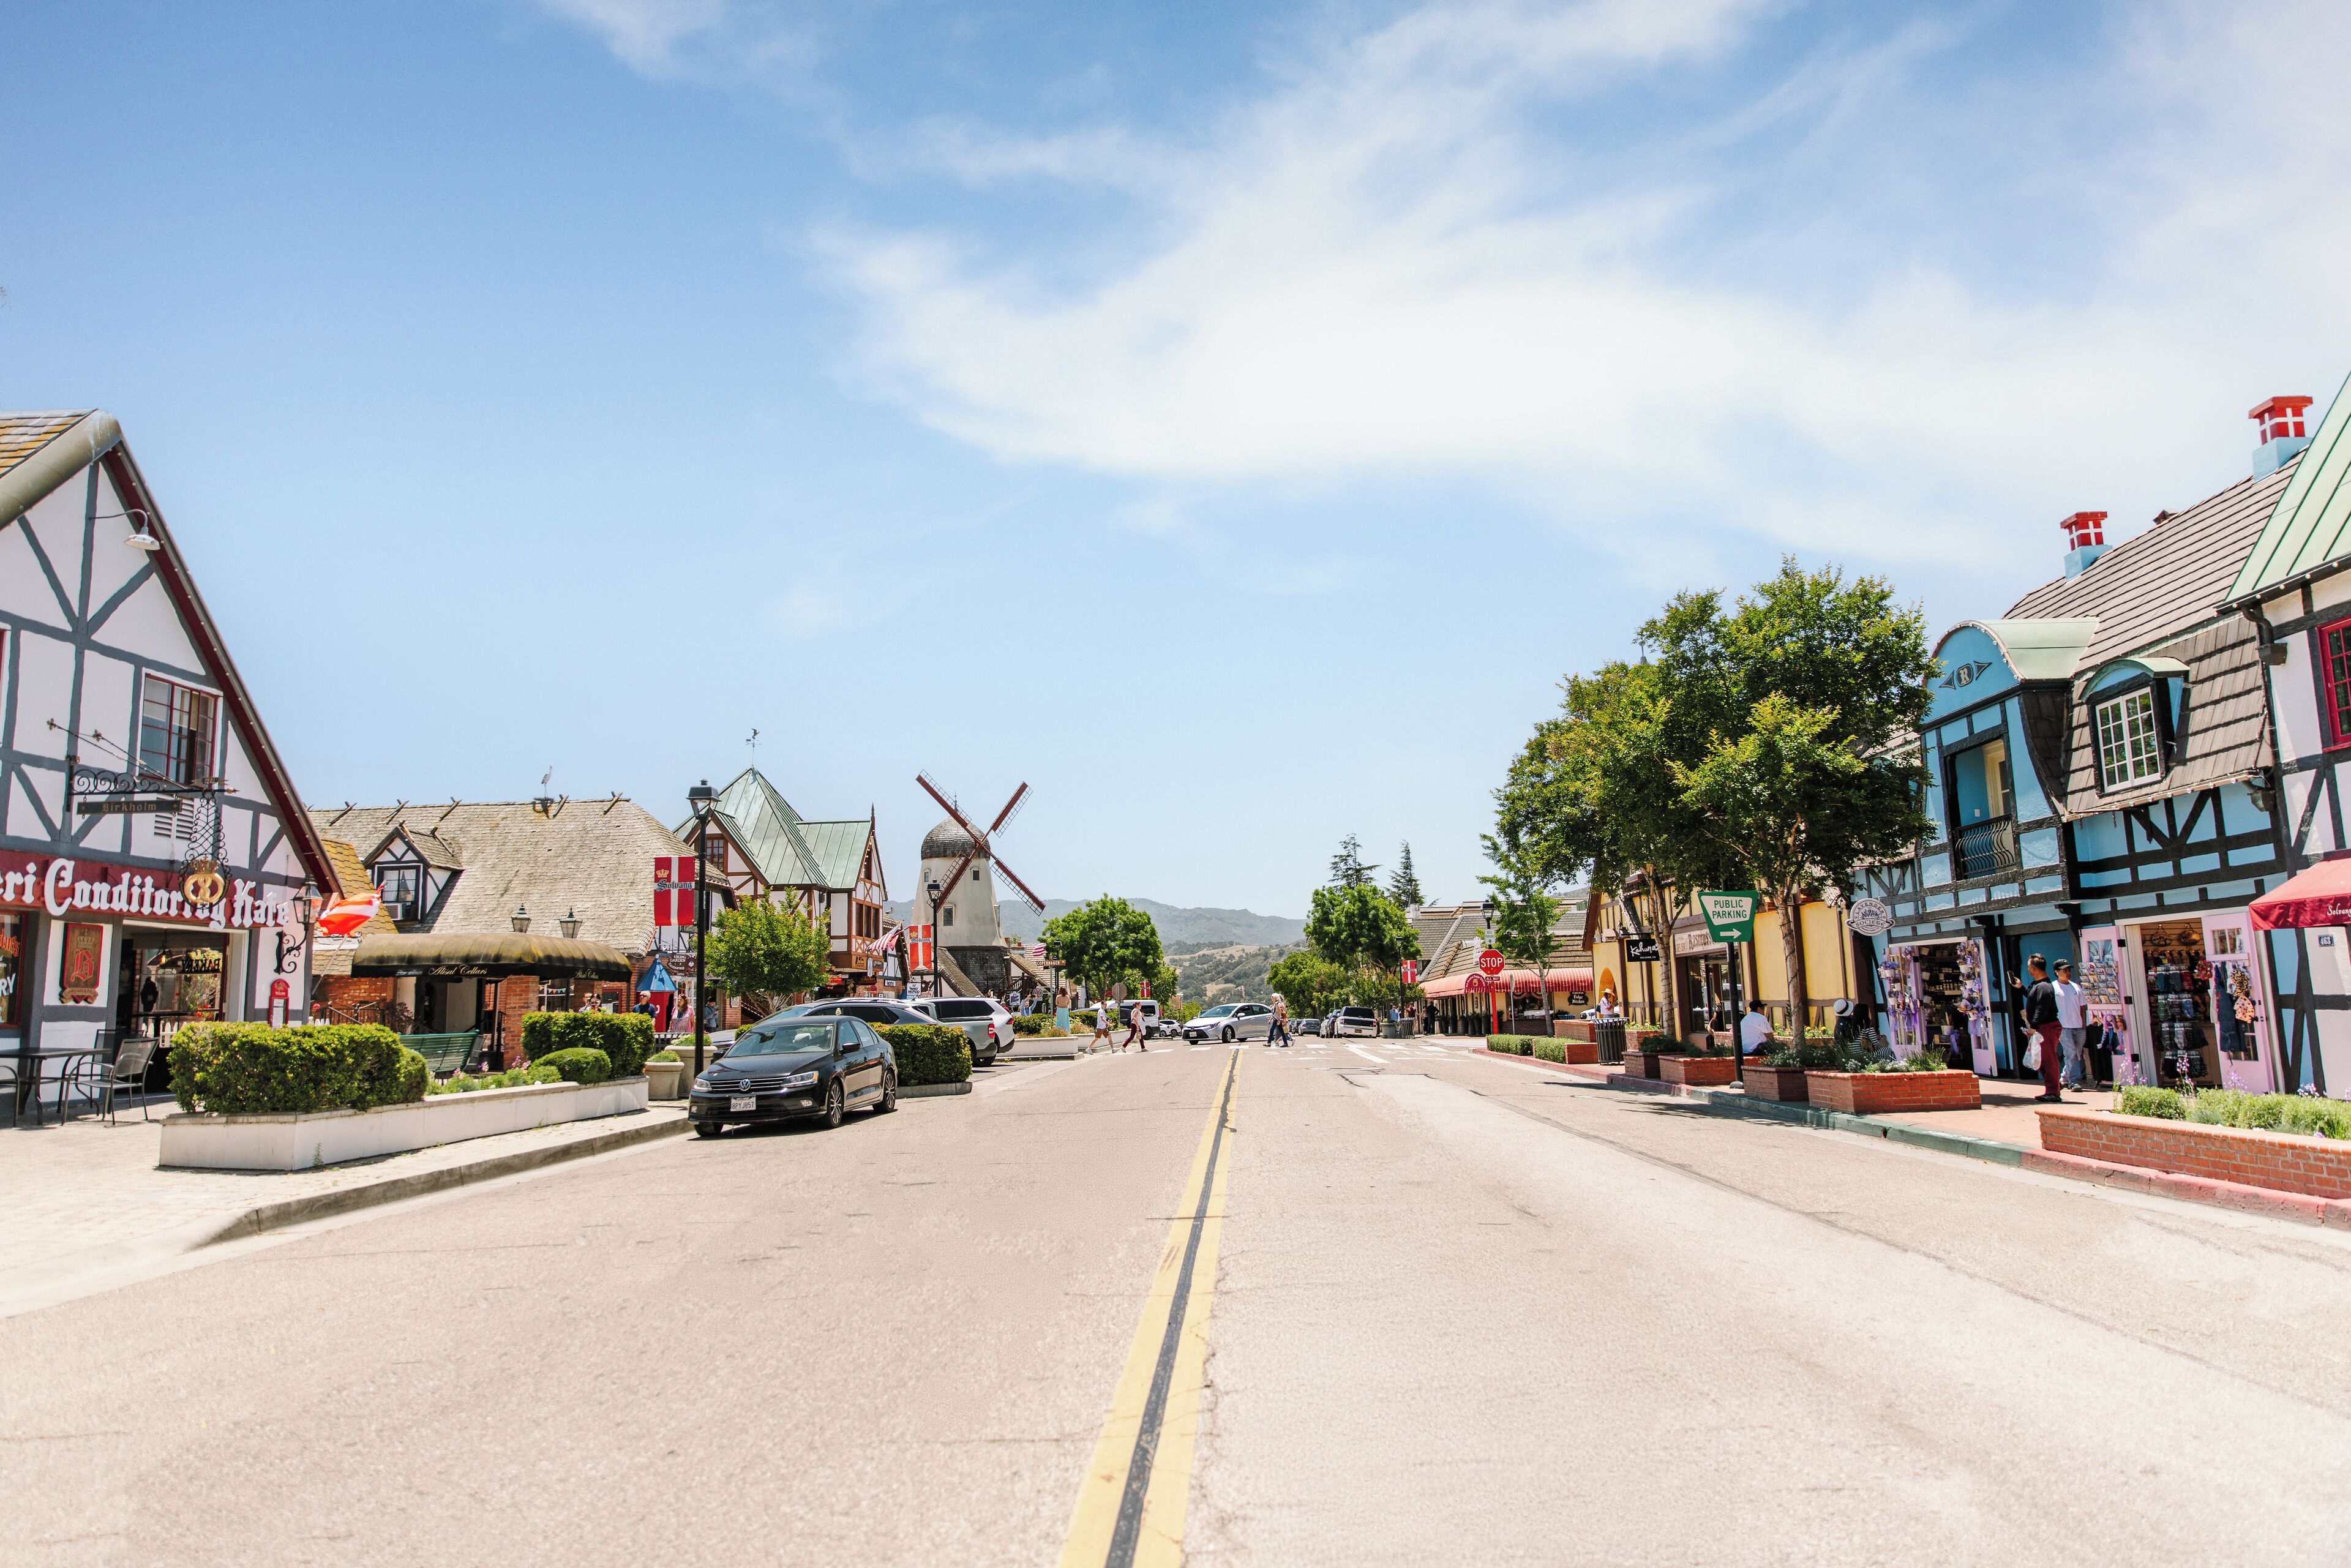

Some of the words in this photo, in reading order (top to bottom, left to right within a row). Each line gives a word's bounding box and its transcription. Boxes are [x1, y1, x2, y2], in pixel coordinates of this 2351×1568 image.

[1959, 667, 1970, 685] R
[102, 802, 157, 812] Birkholm
[656, 879, 692, 891] Solvang
[231, 878, 290, 928] Kafe
[1714, 899, 1744, 909] PUBLIC
[1855, 902, 1884, 915] LAVENDER
[1712, 910, 1747, 919] PARKING
[2320, 936, 2331, 945] 463
[70, 949, 94, 981] B
[1480, 957, 1503, 968] STOP
[429, 966, 458, 975] Alisal
[459, 964, 487, 975] Cellars
